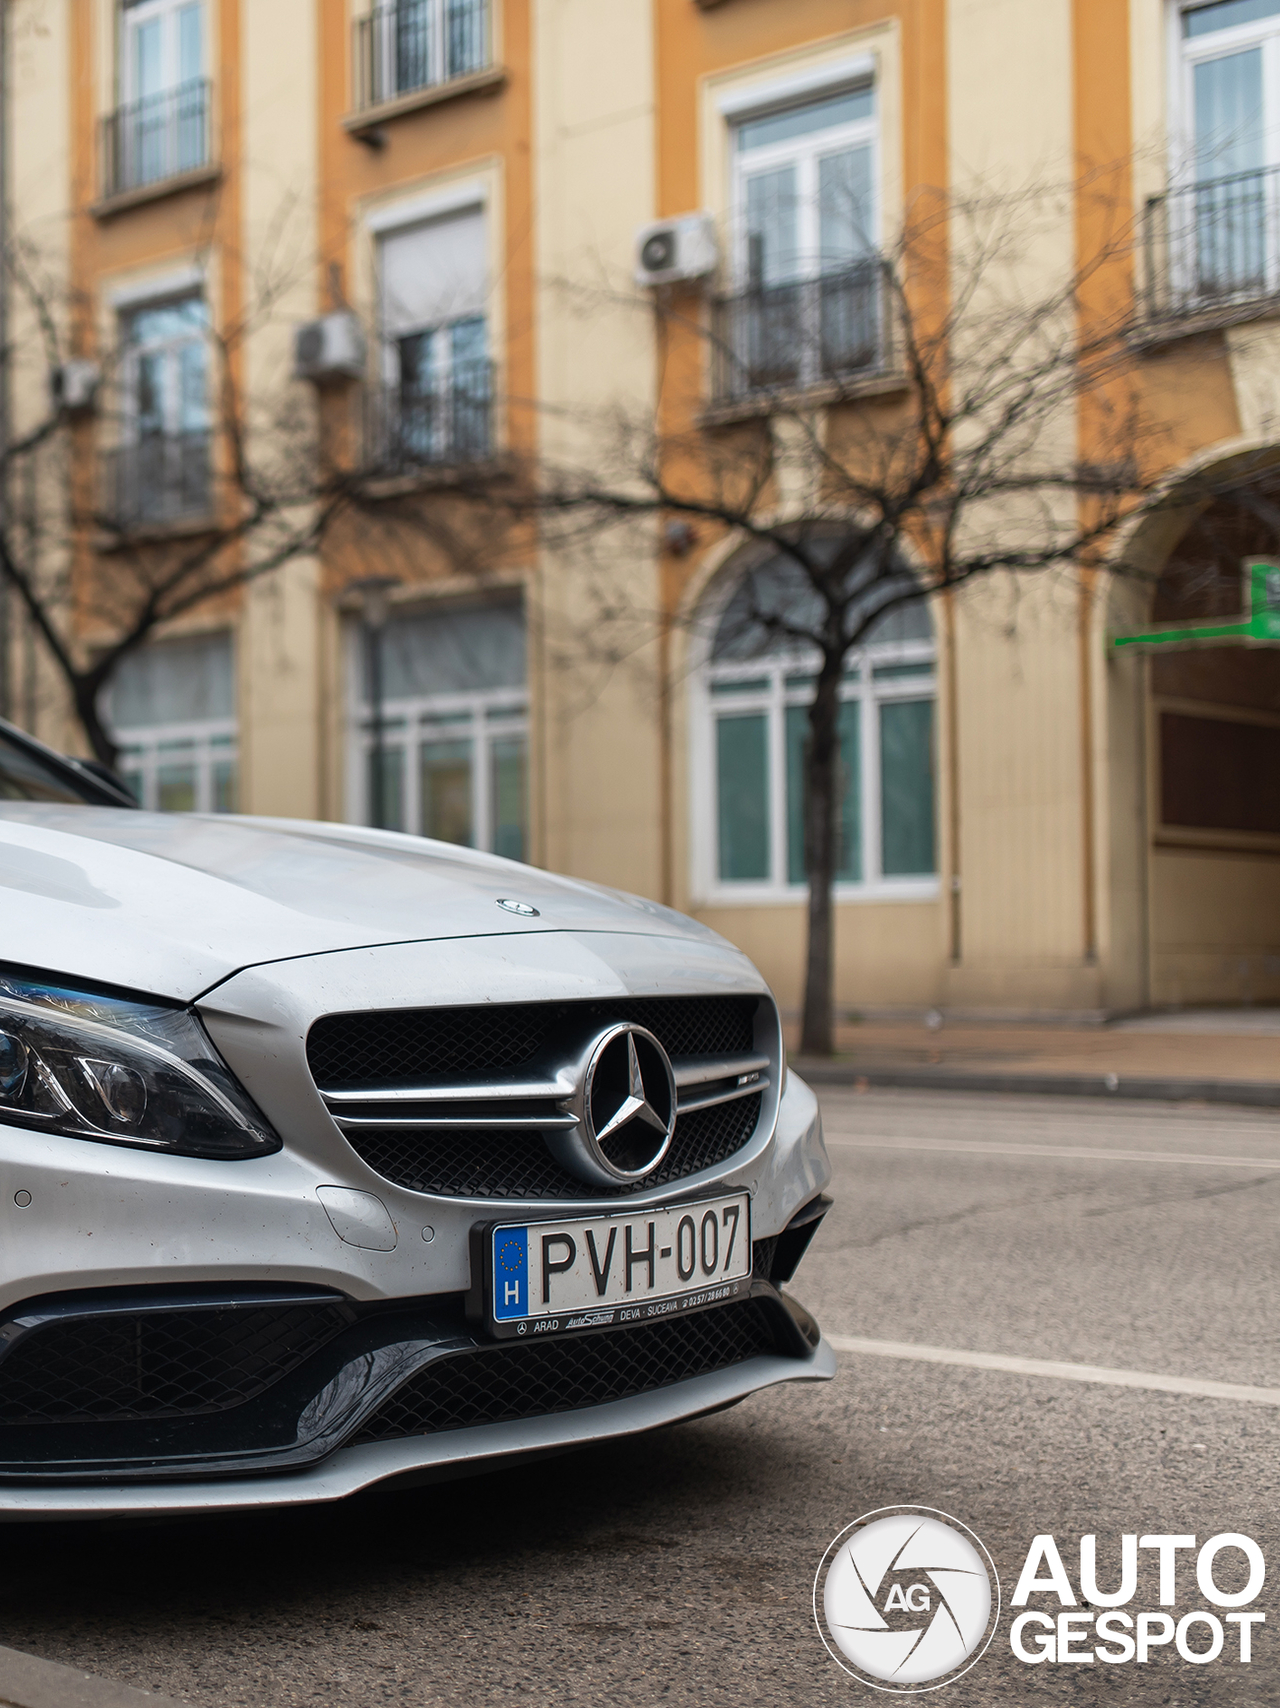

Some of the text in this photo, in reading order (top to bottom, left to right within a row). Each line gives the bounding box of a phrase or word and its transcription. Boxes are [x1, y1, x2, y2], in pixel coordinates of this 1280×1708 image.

[541, 1204, 740, 1304] PVH-007
[504, 1280, 520, 1306] H
[534, 1320, 559, 1332] ARAD
[620, 1309, 640, 1321] DEVA
[647, 1301, 677, 1316] SUCEAVA
